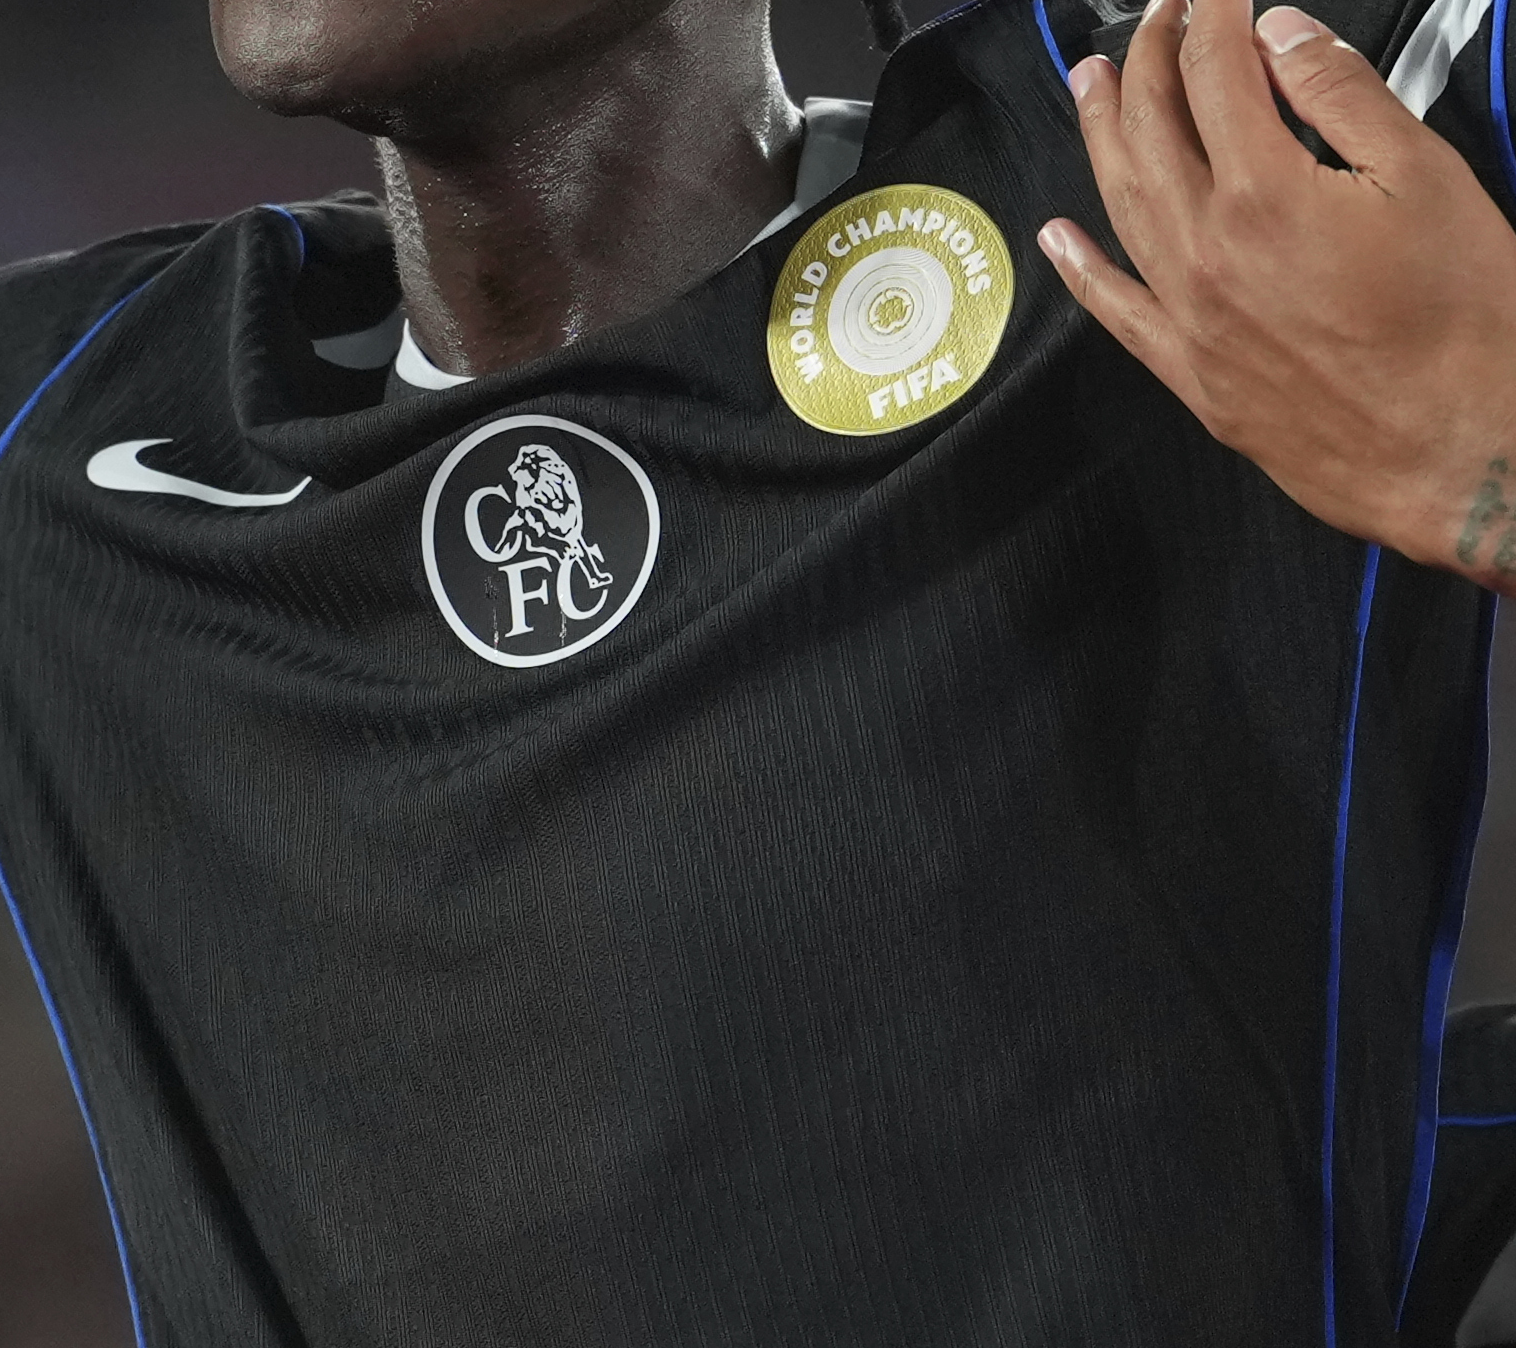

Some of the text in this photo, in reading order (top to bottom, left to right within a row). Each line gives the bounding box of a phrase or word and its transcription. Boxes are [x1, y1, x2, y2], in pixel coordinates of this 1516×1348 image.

[789, 206, 993, 385] WORLD CHAMPIONS
[867, 357, 962, 420] FIFA
